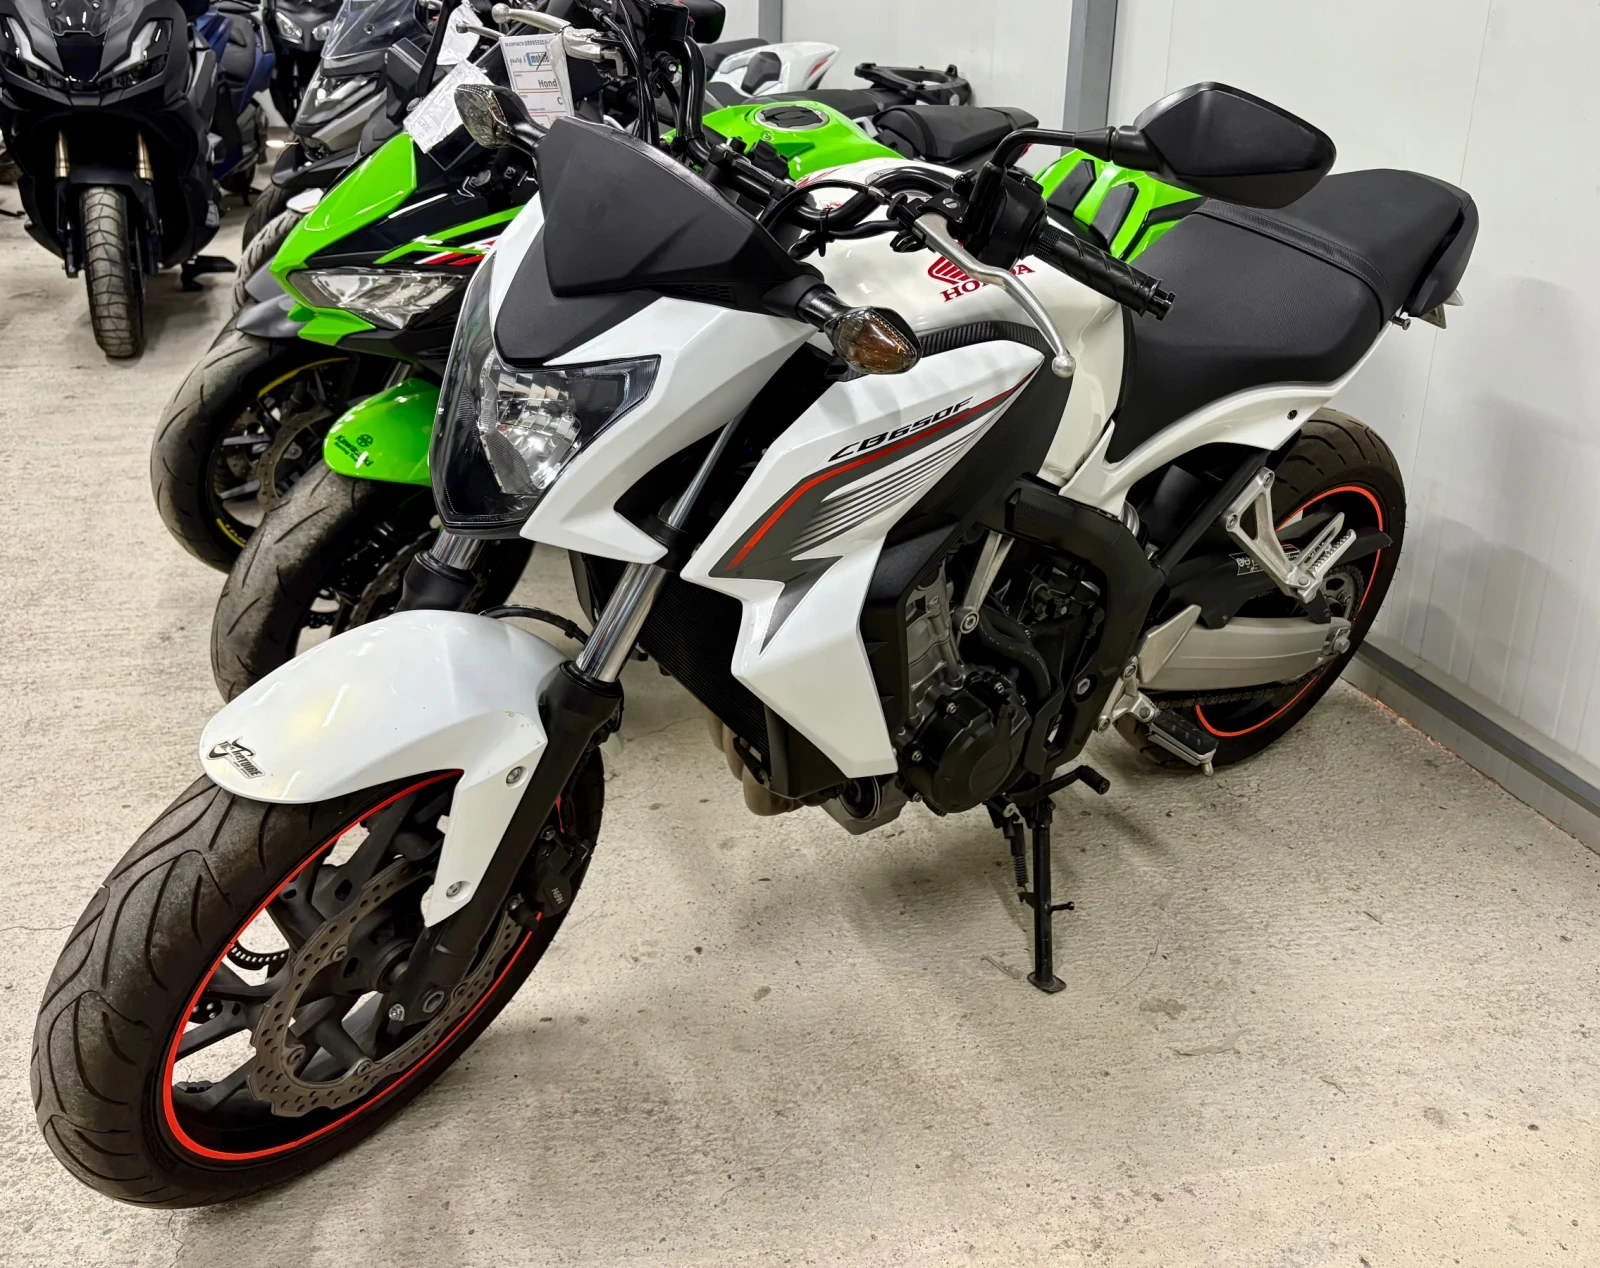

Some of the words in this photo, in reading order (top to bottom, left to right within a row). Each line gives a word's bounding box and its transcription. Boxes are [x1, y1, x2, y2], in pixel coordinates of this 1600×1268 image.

[940, 263, 1036, 303] HOA
[827, 396, 974, 463] CB650F
[335, 434, 374, 467] Kawaski
